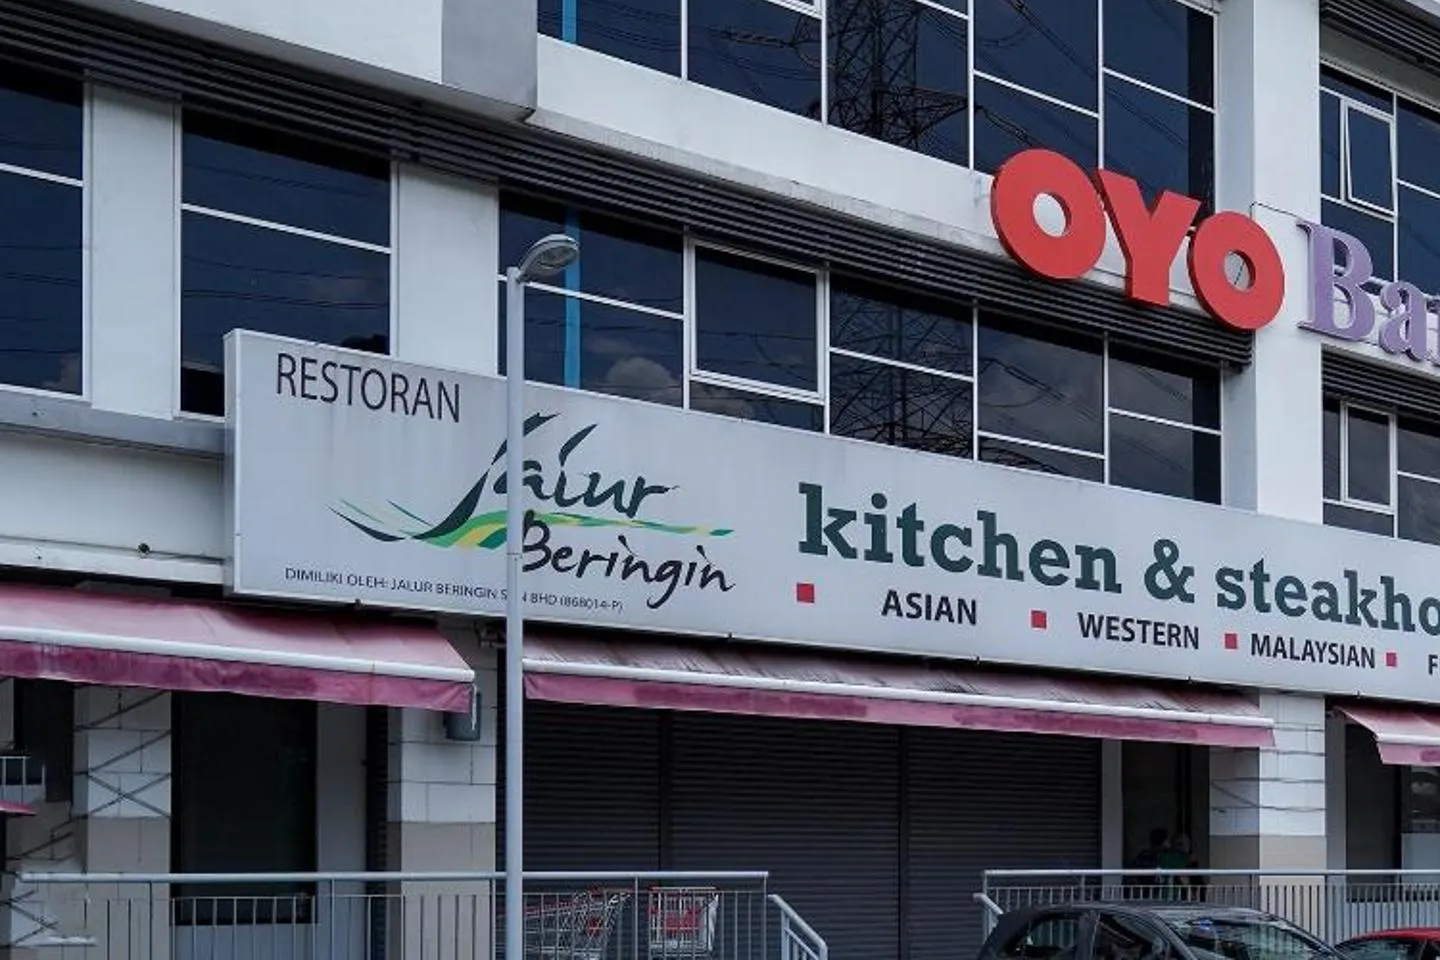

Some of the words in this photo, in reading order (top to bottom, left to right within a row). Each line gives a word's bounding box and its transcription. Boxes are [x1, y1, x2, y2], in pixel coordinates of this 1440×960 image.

[989, 147, 1286, 332] OYO
[275, 352, 461, 424] RESTORAN
[522, 509, 737, 610] Beringin
[797, 480, 1123, 595] kitchen
[1143, 538, 1196, 604] &
[881, 589, 978, 627] ASIAN
[1077, 611, 1200, 651] WESTERN
[1250, 633, 1377, 670] MALAYSIAN
